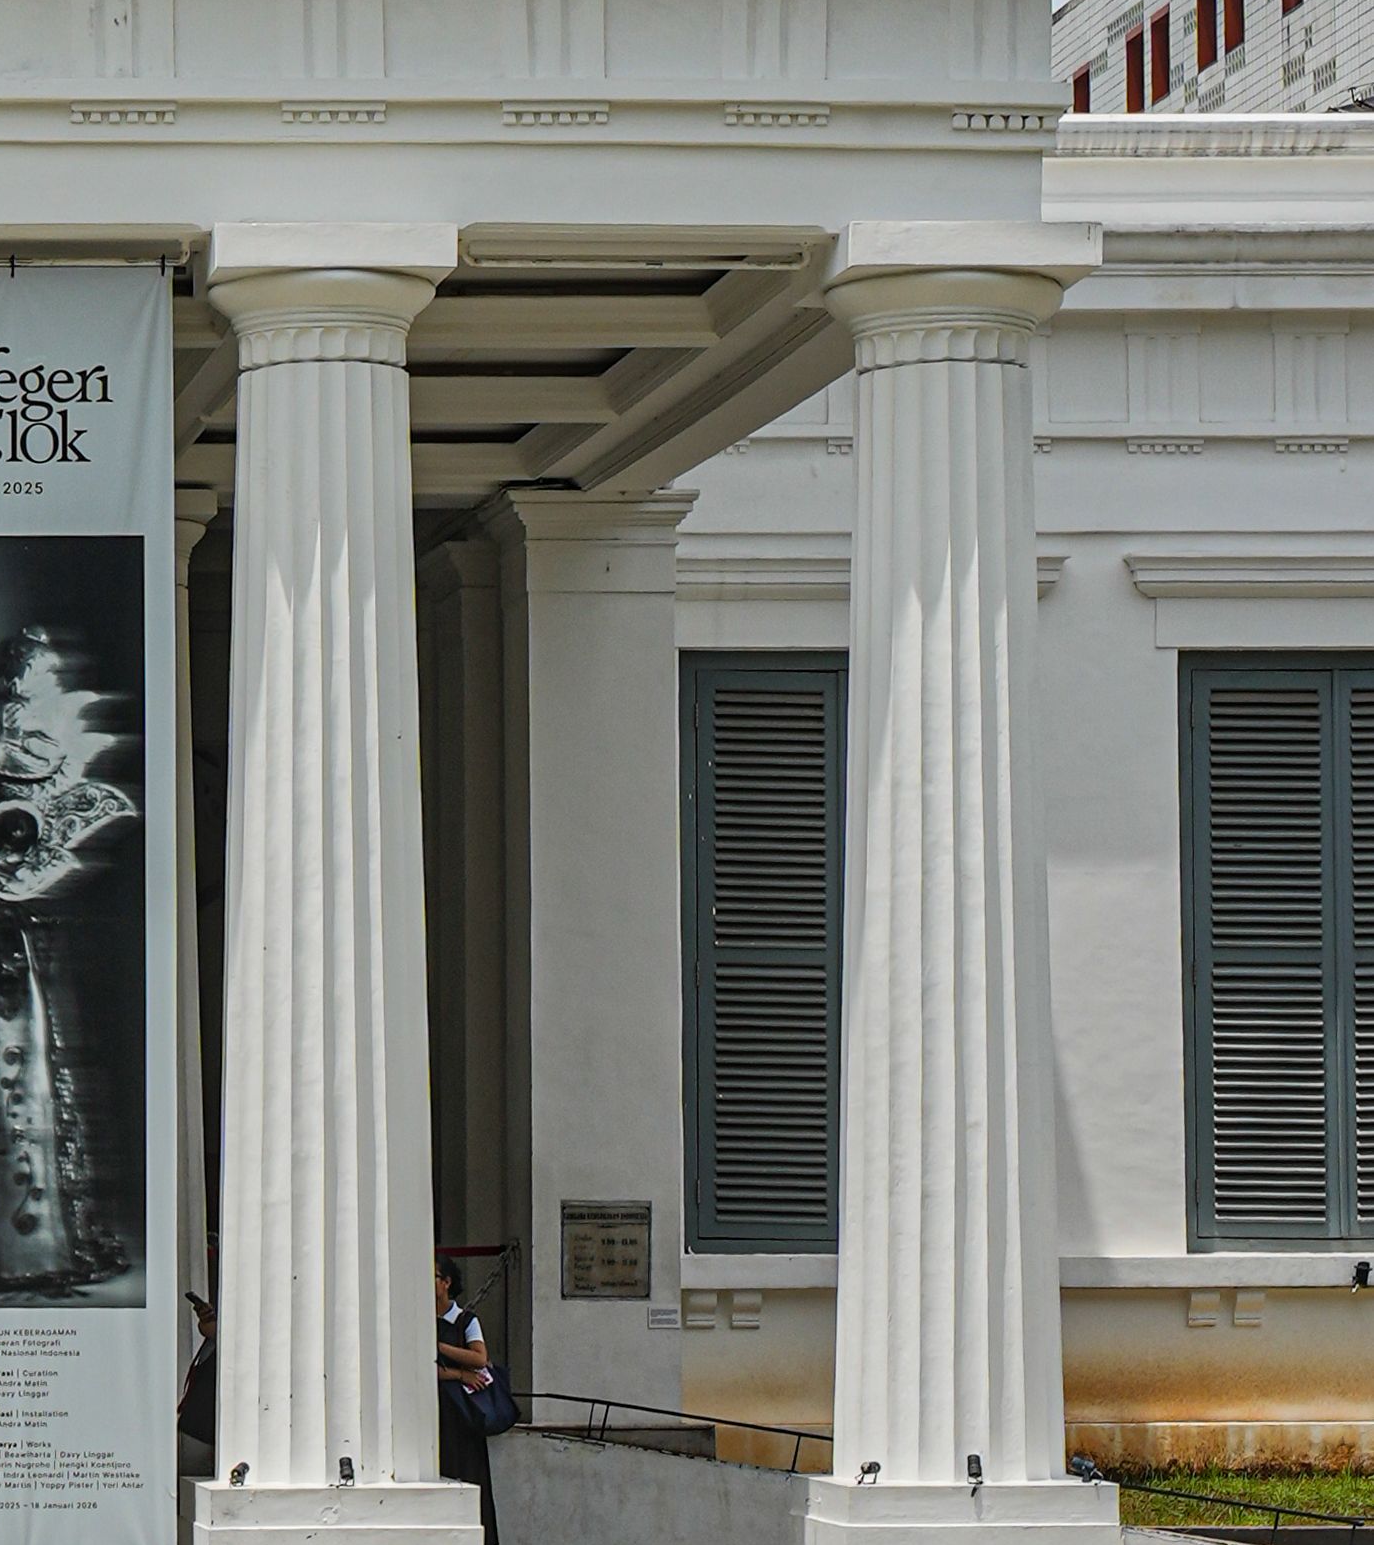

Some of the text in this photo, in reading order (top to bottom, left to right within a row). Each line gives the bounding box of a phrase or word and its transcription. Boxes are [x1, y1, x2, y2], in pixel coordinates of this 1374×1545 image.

[2, 482, 44, 495] 2025
[22, 1339, 61, 1347] Fotografi
[84, 1451, 115, 1459] Linggar
